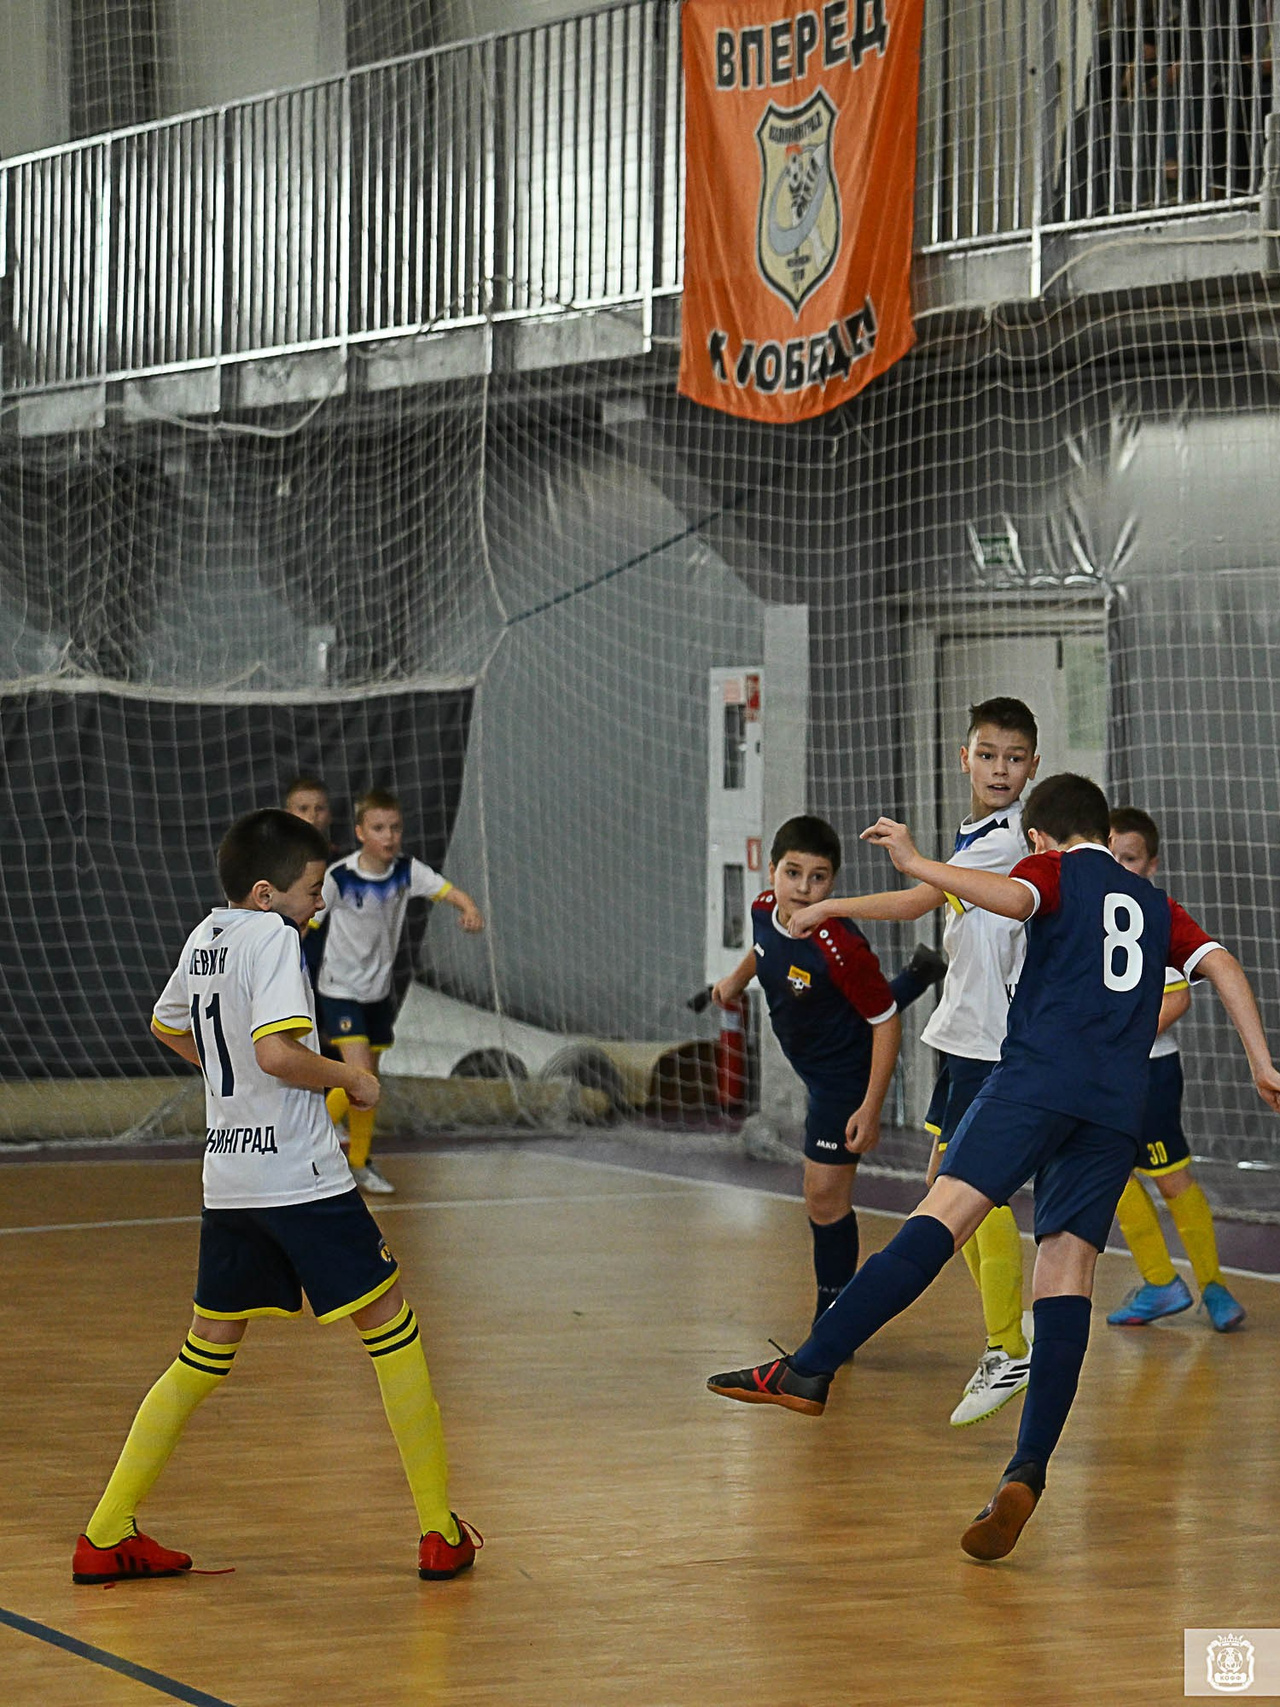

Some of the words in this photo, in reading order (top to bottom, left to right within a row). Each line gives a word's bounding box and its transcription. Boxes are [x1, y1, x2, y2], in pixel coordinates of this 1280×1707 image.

[716, 0, 890, 91] ВПЕРЕД
[1103, 892, 1144, 992] 8
[191, 992, 234, 1097] 11
[816, 1139, 838, 1150] JAKO
[1146, 1140, 1168, 1166] 30
